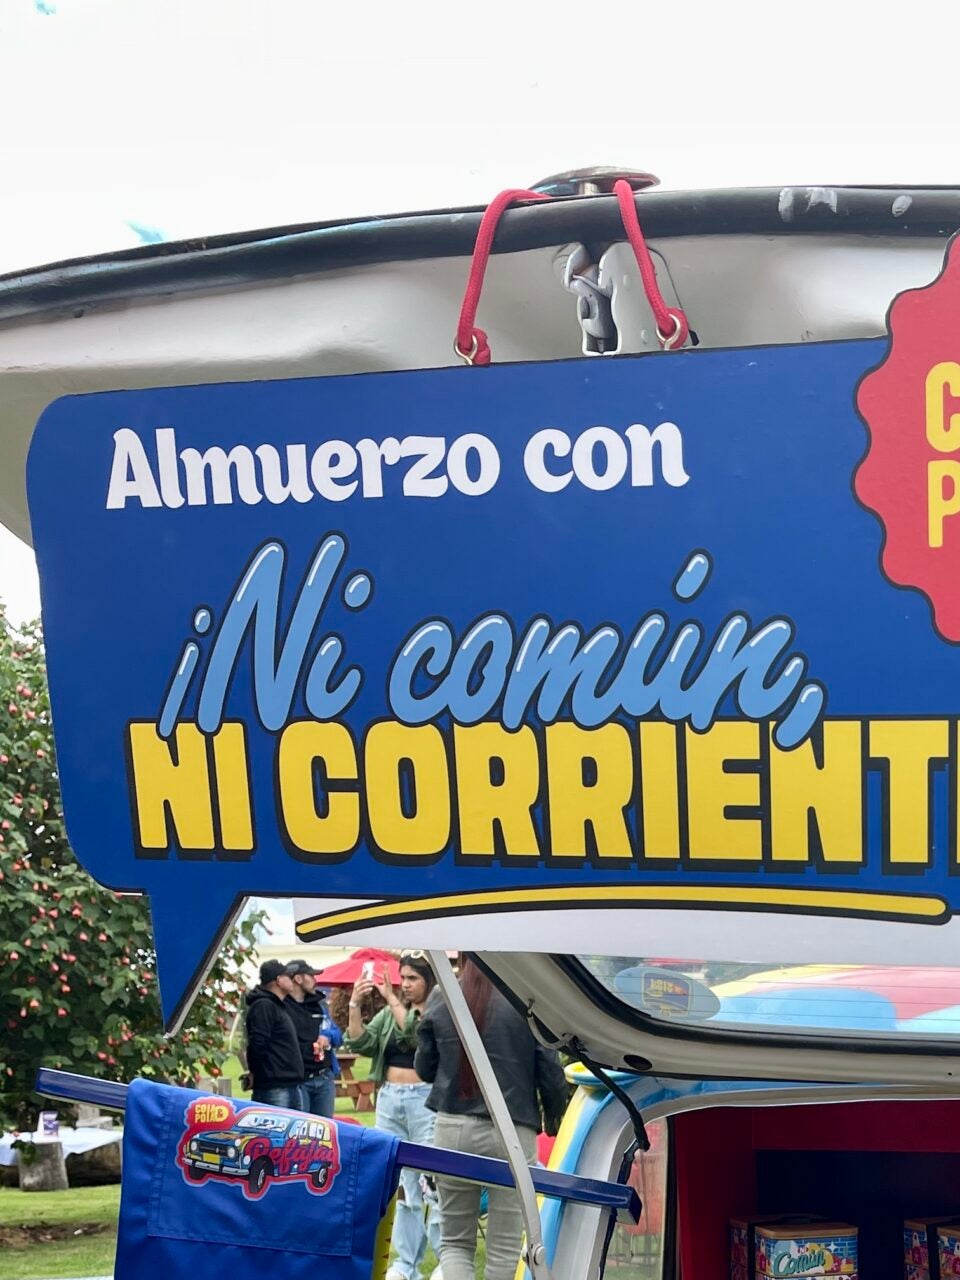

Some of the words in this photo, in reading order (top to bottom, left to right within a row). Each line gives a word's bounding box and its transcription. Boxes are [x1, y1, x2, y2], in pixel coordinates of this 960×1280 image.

[105, 426, 500, 510] Almuerzo
[522, 421, 690, 493] con
[127, 719, 258, 856] NI
